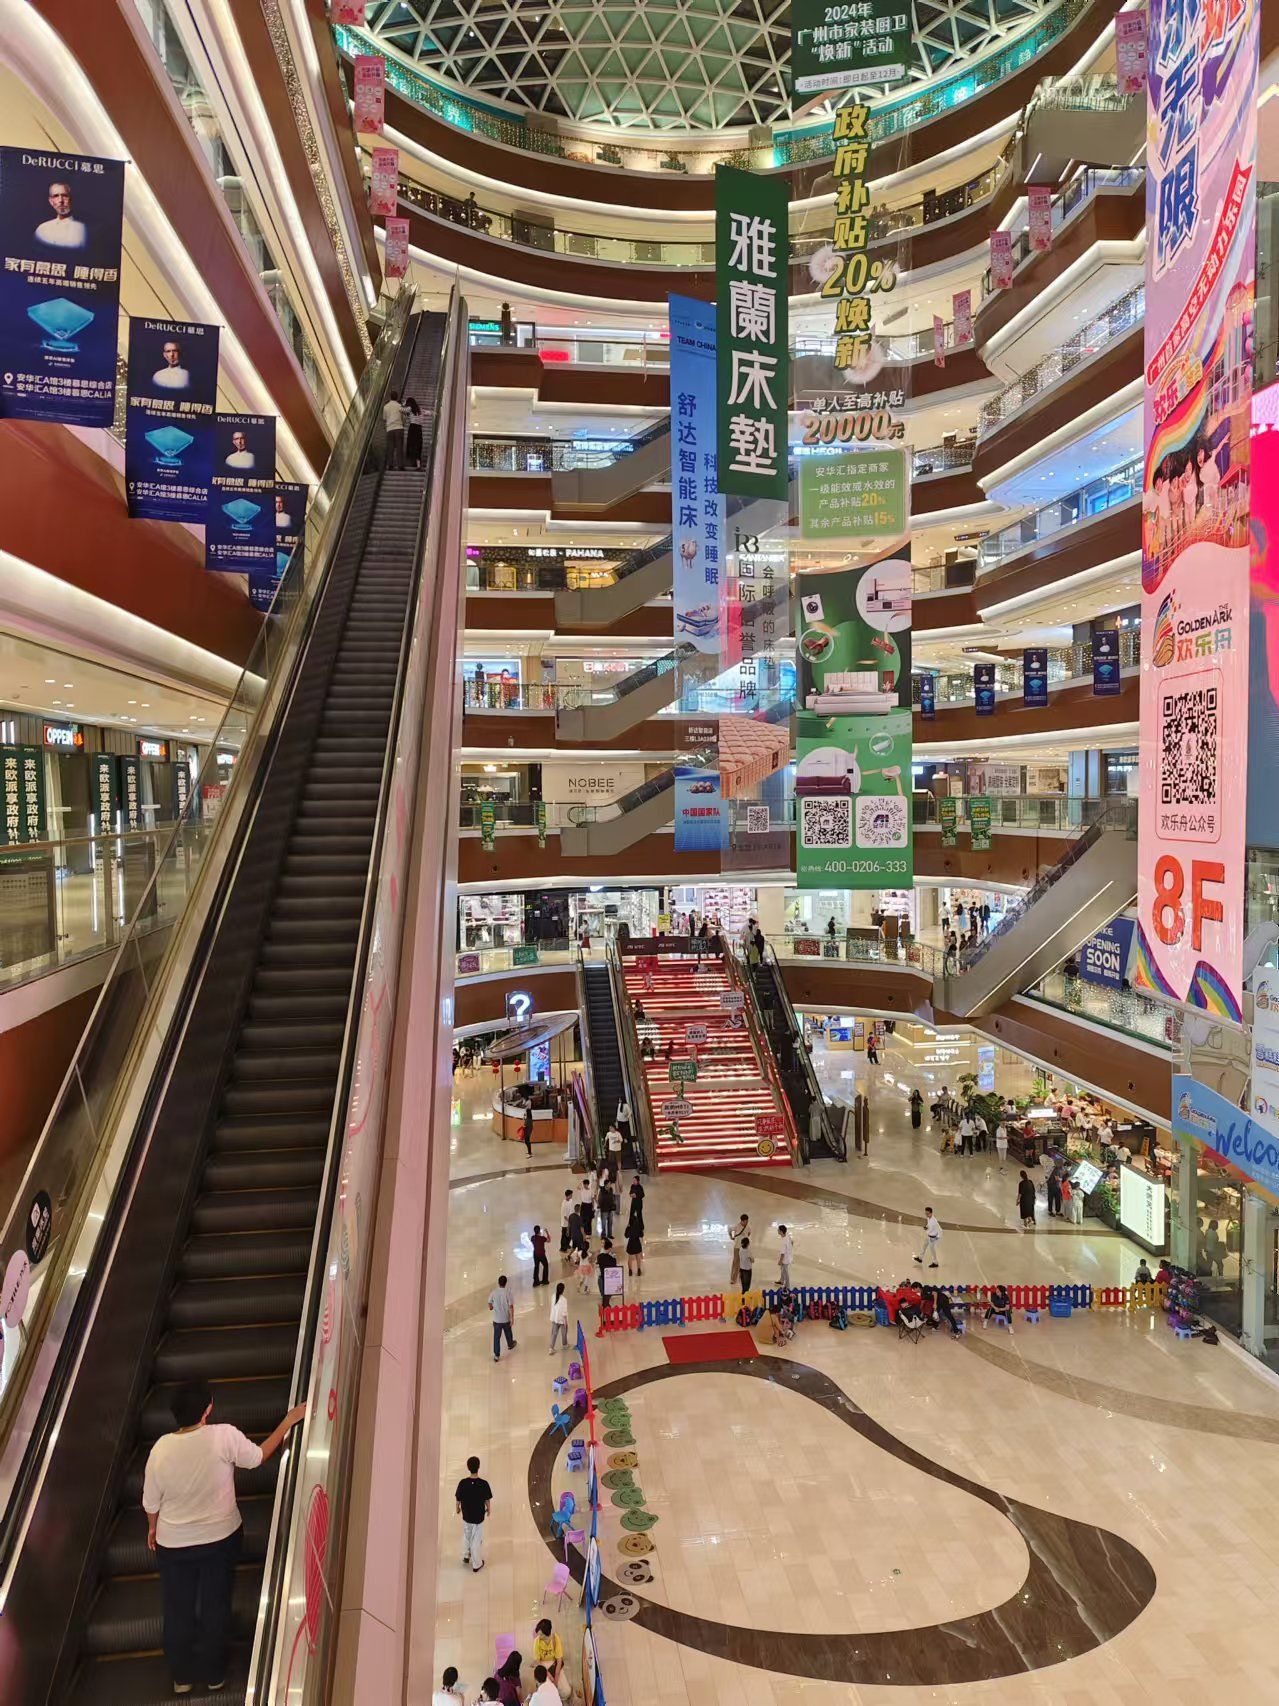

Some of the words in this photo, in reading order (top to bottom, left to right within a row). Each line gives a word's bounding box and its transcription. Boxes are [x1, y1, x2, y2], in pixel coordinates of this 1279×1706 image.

[825, 2, 873, 21] 2024年
[798, 14, 907, 45] 广州市家装厨卫
[22, 154, 78, 171] DeRUCCI
[144, 321, 186, 334] DeRUCCI
[677, 335, 696, 347] TEAM
[727, 212, 778, 476] 雅蘭床墊
[811, 389, 905, 413] 单人至高补贴
[802, 410, 905, 445] 20000元
[677, 392, 698, 529] 舒达智能床
[815, 462, 890, 477] 安华汇指定商家
[704, 453, 719, 585] 科技改变睡眠
[568, 778, 615, 788] NOBEE
[98, 764, 112, 835] 来欧派享政府补
[1160, 814, 1216, 834] 欢乐舟公众号
[824, 861, 907, 873] 400-0206-333
[1152, 854, 1226, 952] 8F
[1086, 949, 1120, 971] SOON
[1215, 1119, 1279, 1167] Welco
